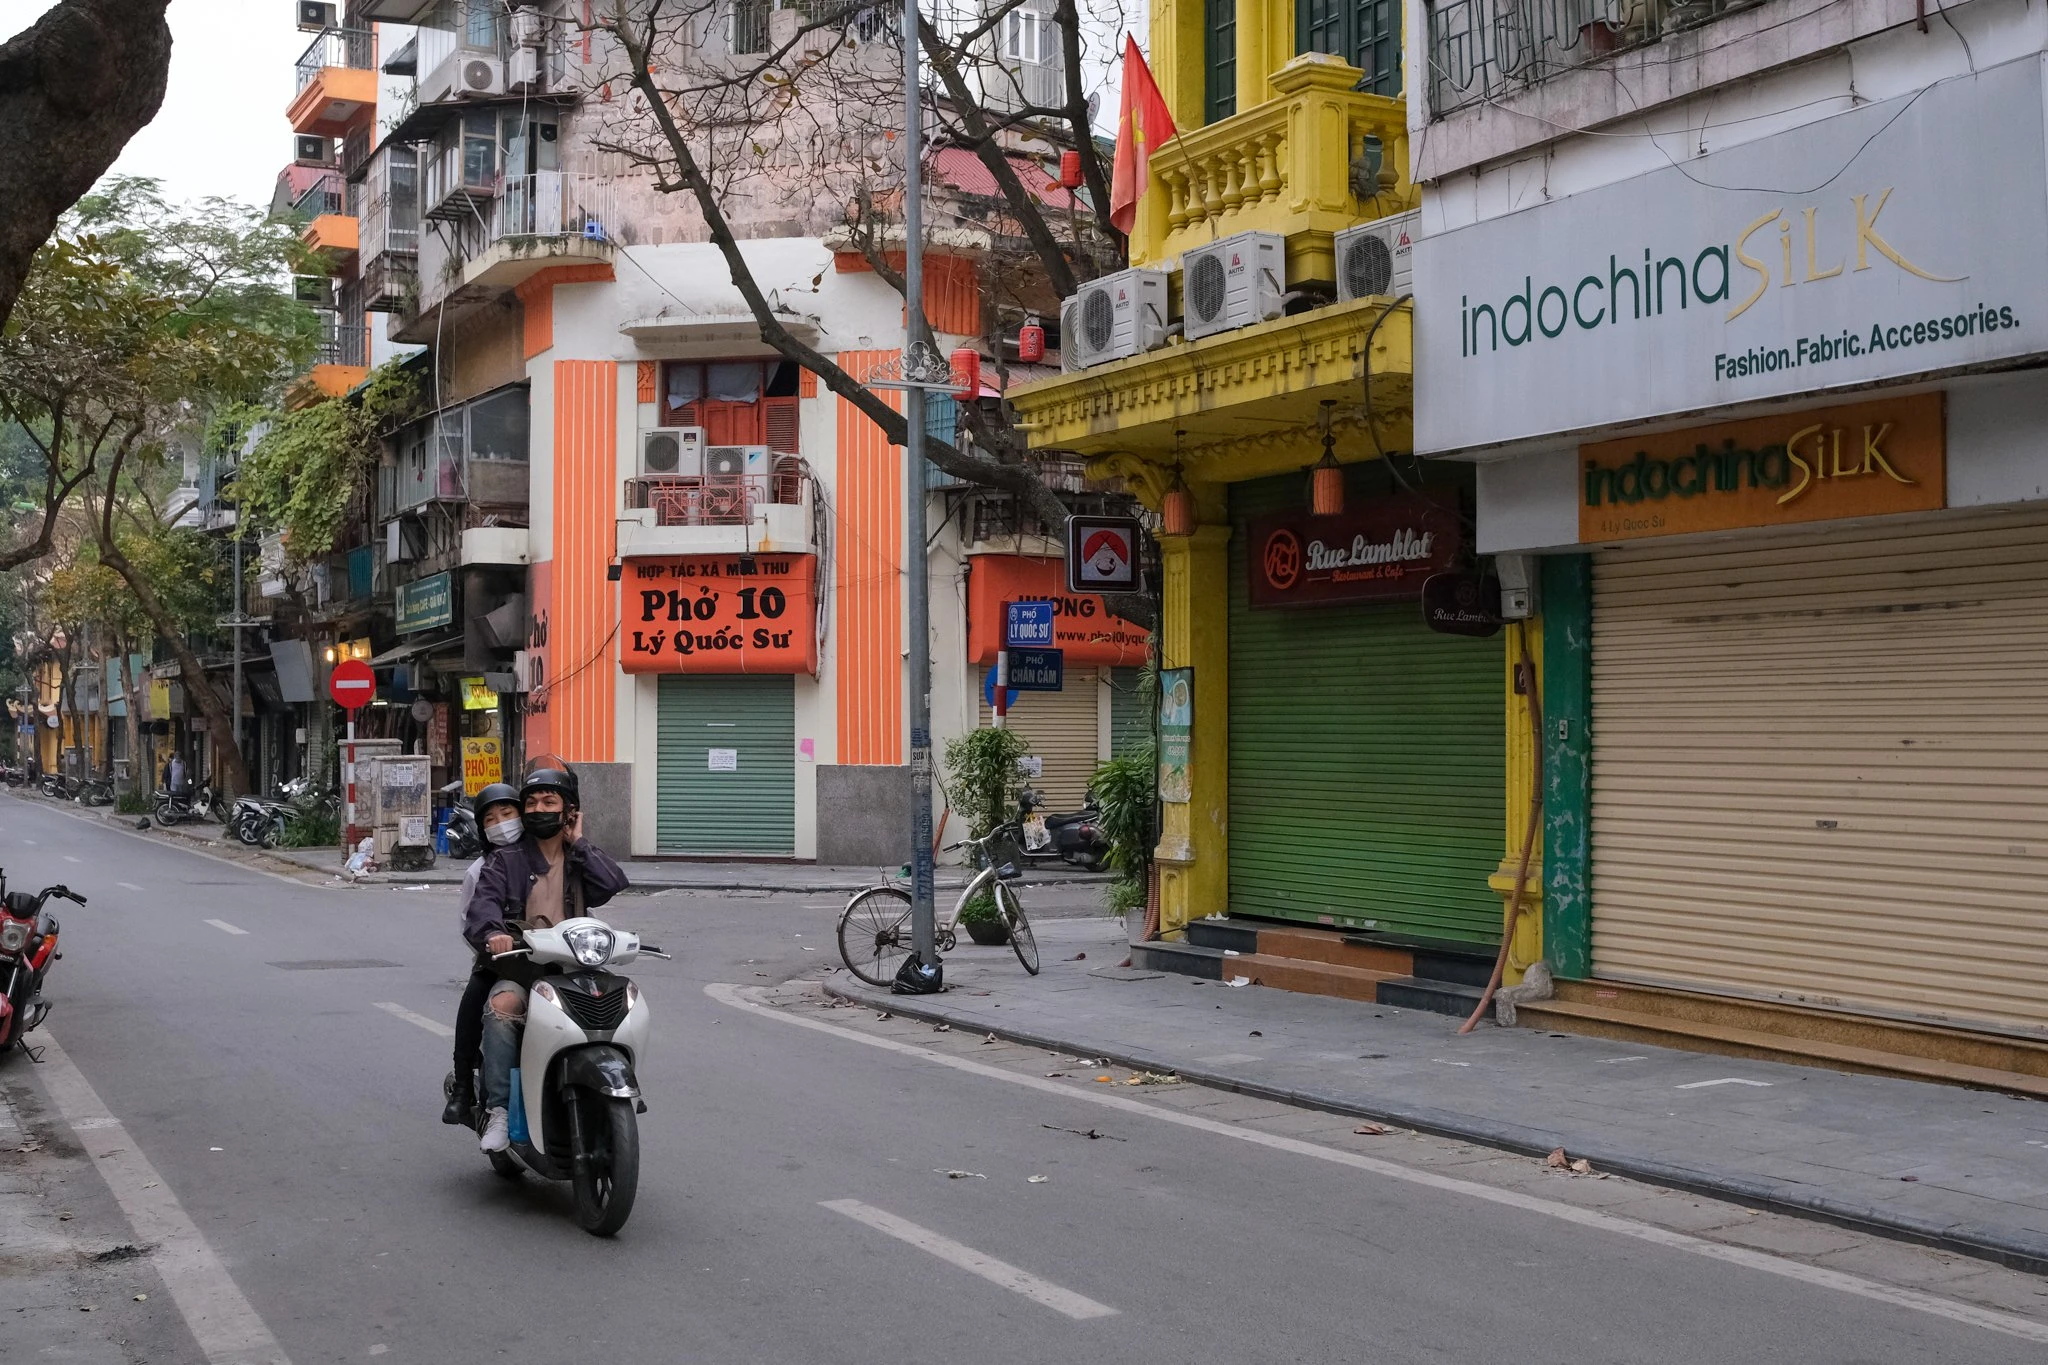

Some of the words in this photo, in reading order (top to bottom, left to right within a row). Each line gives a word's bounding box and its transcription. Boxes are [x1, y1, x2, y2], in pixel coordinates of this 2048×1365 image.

[1462, 244, 1730, 357] indochina
[1585, 438, 1791, 507] indochina
[669, 561, 696, 578] TÁC
[761, 561, 789, 575] THU
[1305, 540, 1344, 571] Rue
[640, 585, 719, 622] Phở
[736, 586, 786, 619] 10
[1022, 606, 1037, 619] PHỐ
[632, 629, 666, 655] Lý
[673, 625, 743, 655] Quốc
[752, 628, 793, 649] Sư
[1010, 620, 1018, 639] LÝ
[1019, 619, 1038, 641] QUỐC
